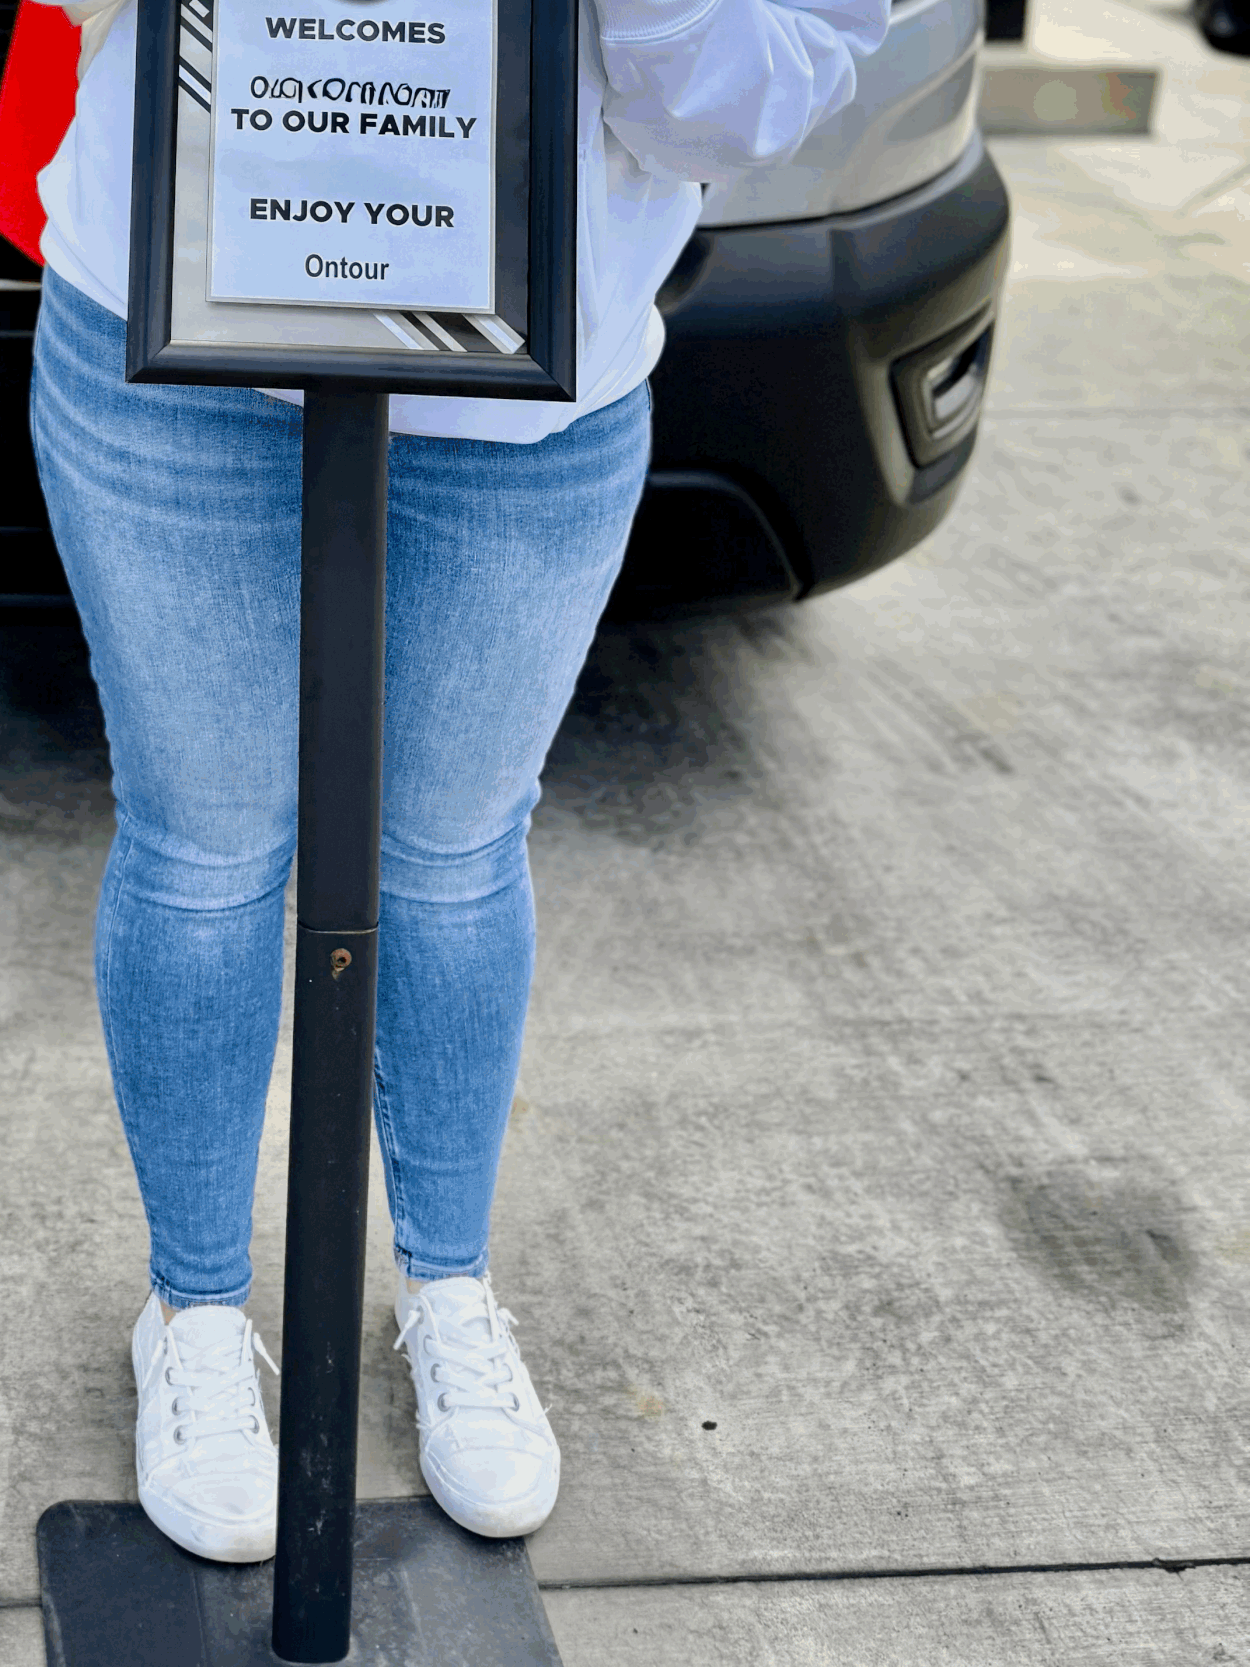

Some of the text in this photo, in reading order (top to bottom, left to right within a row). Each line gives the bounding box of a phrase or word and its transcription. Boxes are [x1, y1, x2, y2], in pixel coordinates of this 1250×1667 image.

[265, 16, 446, 45] WELCOMES
[230, 108, 478, 139] TO OUR FAMILY
[249, 198, 455, 228] ENJOY YOUR
[304, 253, 390, 280] Ontour
